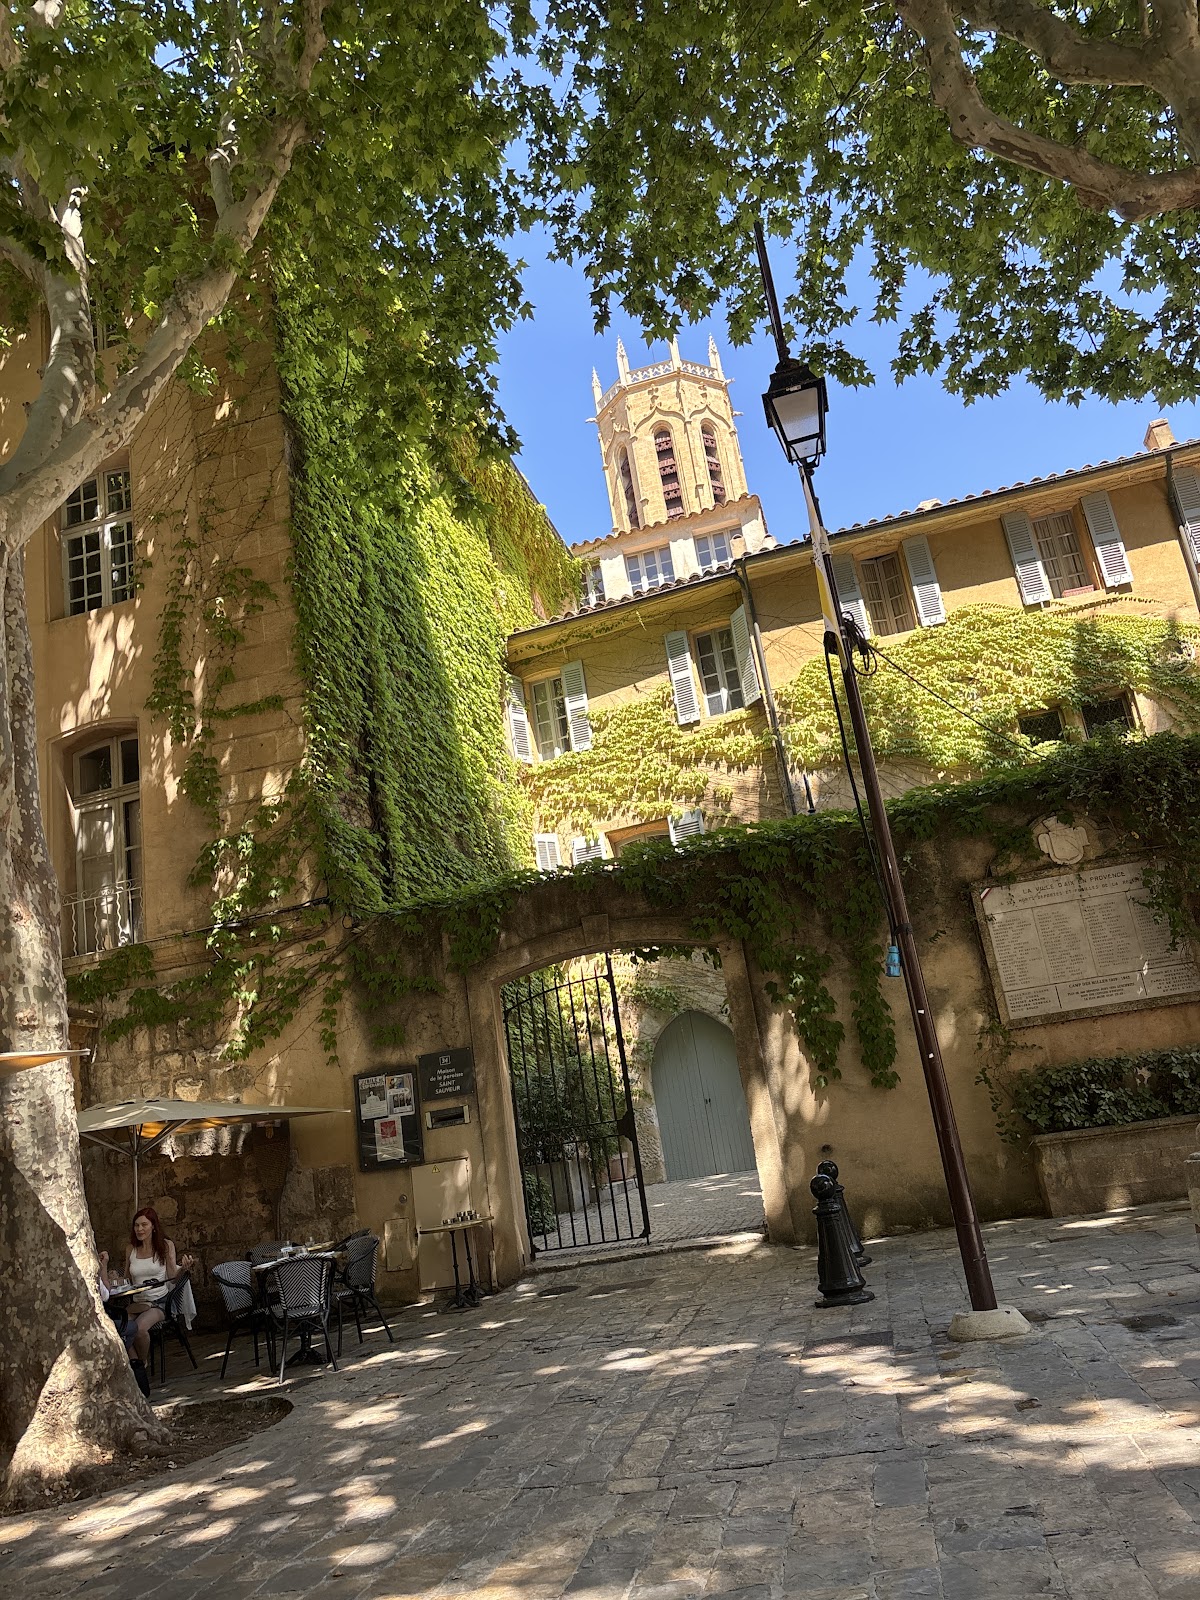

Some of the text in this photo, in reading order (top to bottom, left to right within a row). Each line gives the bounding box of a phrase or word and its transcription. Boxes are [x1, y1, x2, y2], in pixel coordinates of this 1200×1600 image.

[1089, 871, 1126, 882] PROVENCE
[436, 1067, 456, 1075] Maison
[443, 1072, 464, 1080] paroisse
[438, 1079, 456, 1088] SAINT
[435, 1085, 461, 1095] SAUVEUR
